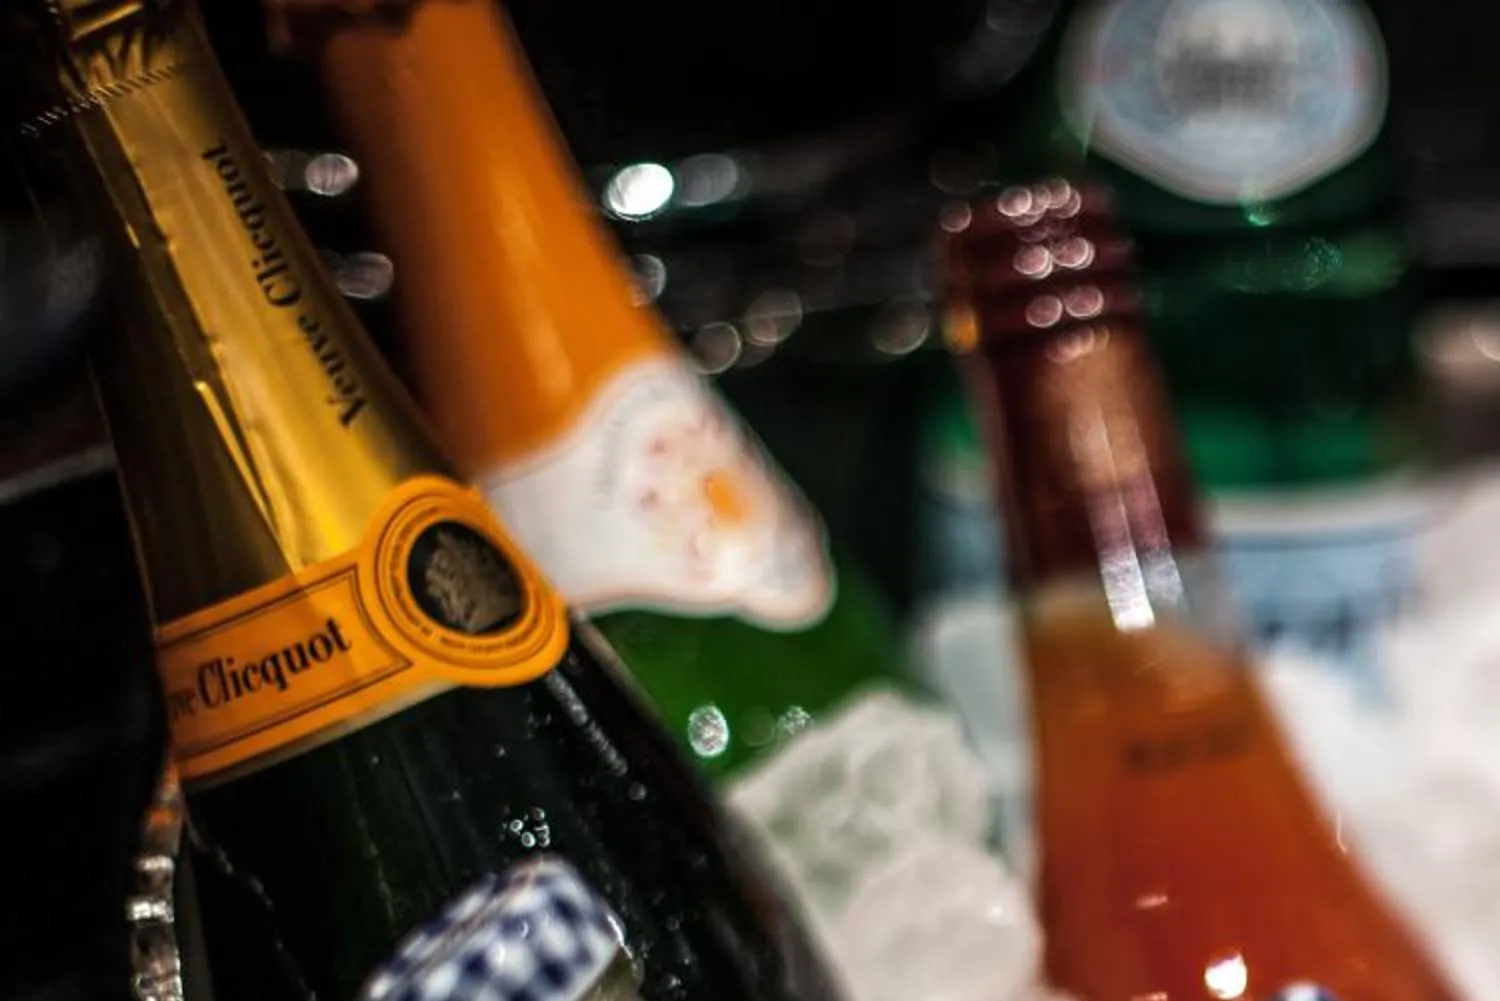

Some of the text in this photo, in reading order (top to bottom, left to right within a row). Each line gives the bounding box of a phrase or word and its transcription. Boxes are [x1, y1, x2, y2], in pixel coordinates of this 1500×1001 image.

[201, 145, 366, 427] Veuve Clicquot
[196, 617, 352, 709] Clicquot
